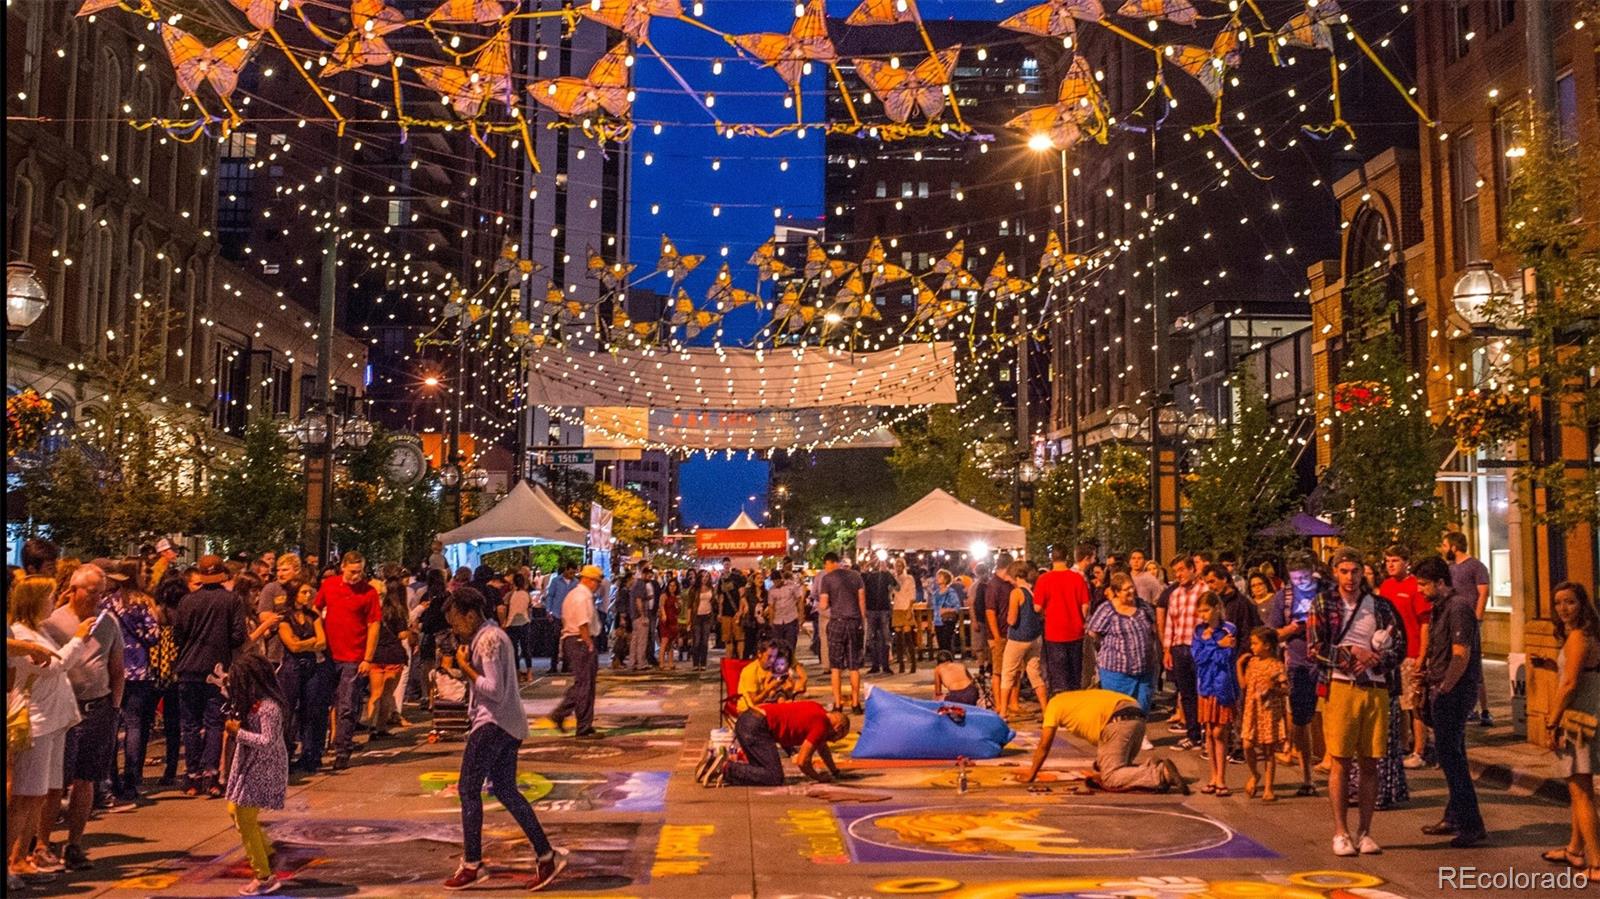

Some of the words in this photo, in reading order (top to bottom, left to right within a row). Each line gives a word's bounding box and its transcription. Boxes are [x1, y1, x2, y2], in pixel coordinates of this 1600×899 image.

[558, 454, 578, 463] 15th
[701, 542, 748, 550] FEATURED
[749, 541, 783, 550] ARTIST
